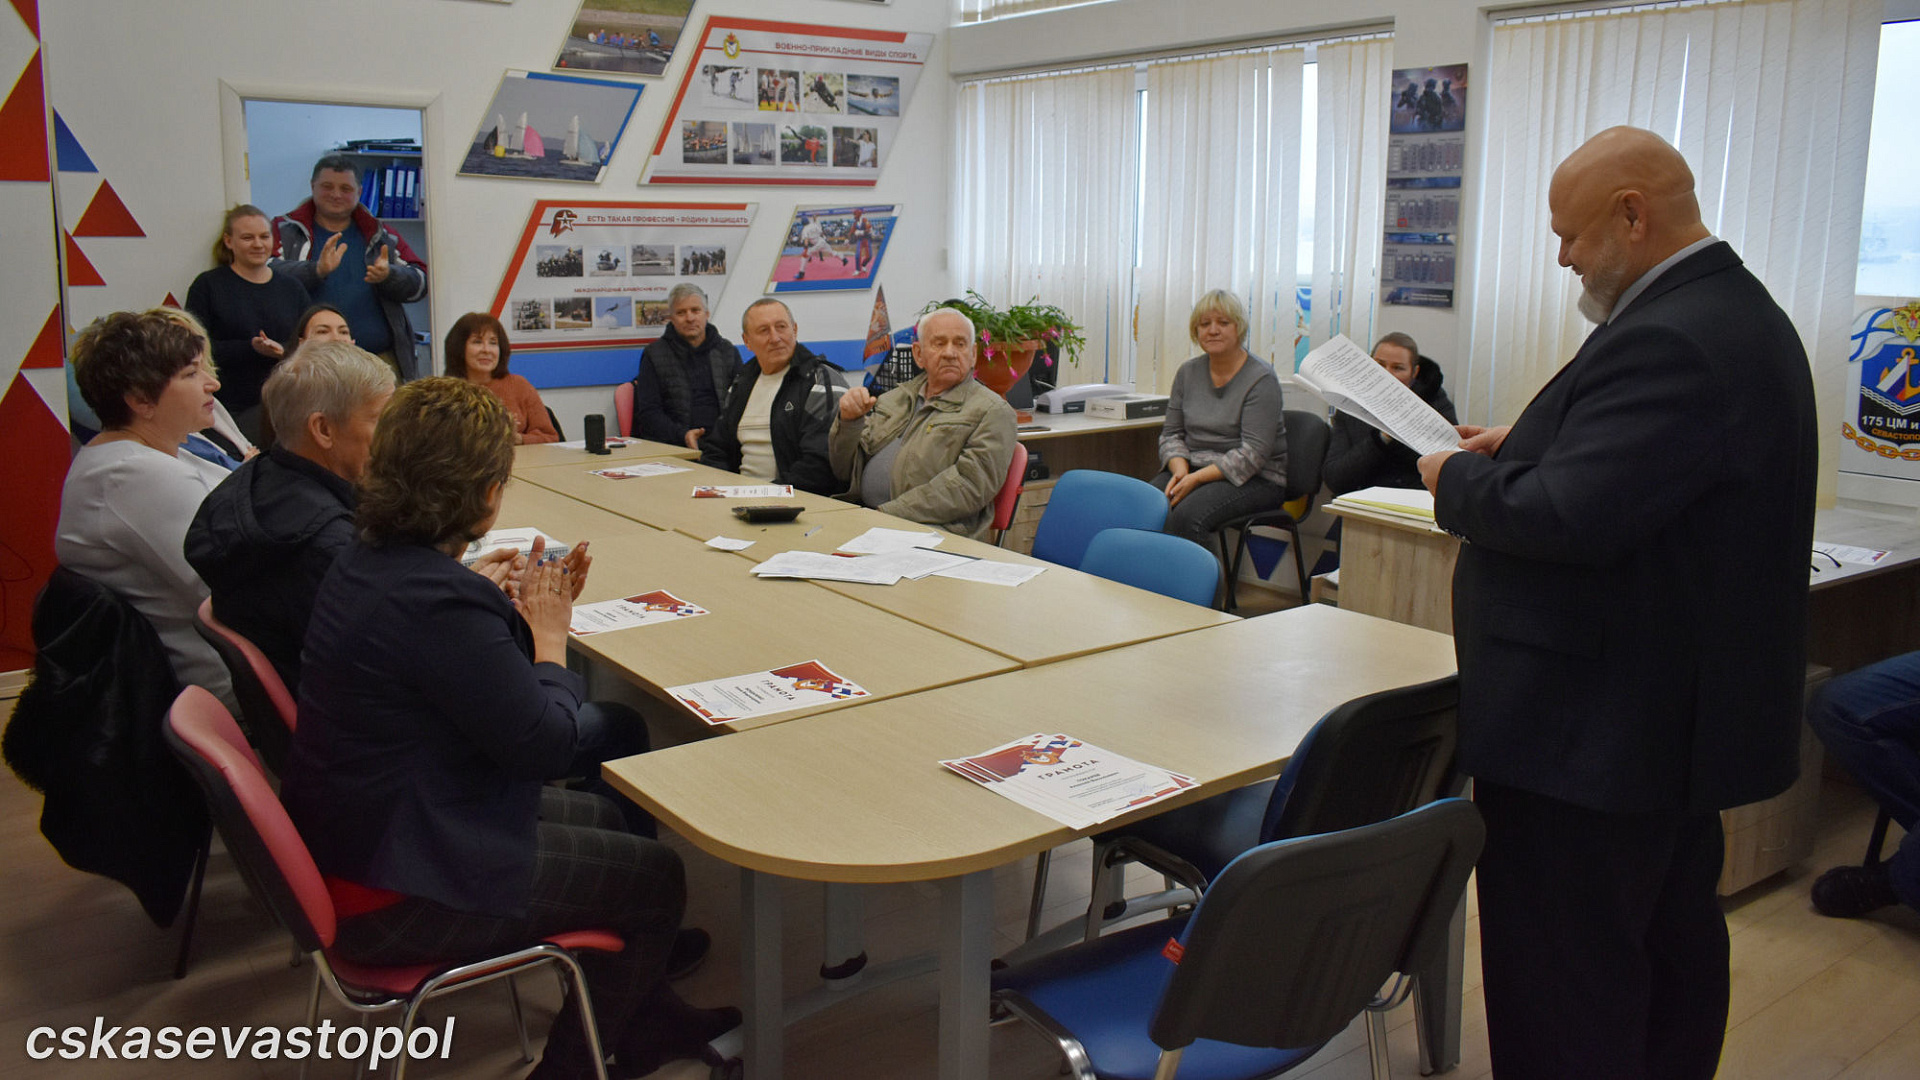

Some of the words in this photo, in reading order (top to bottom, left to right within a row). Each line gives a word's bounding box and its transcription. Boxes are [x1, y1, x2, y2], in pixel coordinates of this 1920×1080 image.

[775, 41, 863, 56] ВОЕННО-ПРИКЛАДНЫЕ
[865, 49, 887, 57] ВИДЫ
[681, 216, 708, 224] РОДИНУ
[1861, 415, 1883, 427] 175
[1886, 417, 1907, 430] ЦМ
[1910, 421, 1920, 430] и
[761, 679, 796, 701] ГРАМОТА
[1037, 759, 1099, 780] ГРАМОТА
